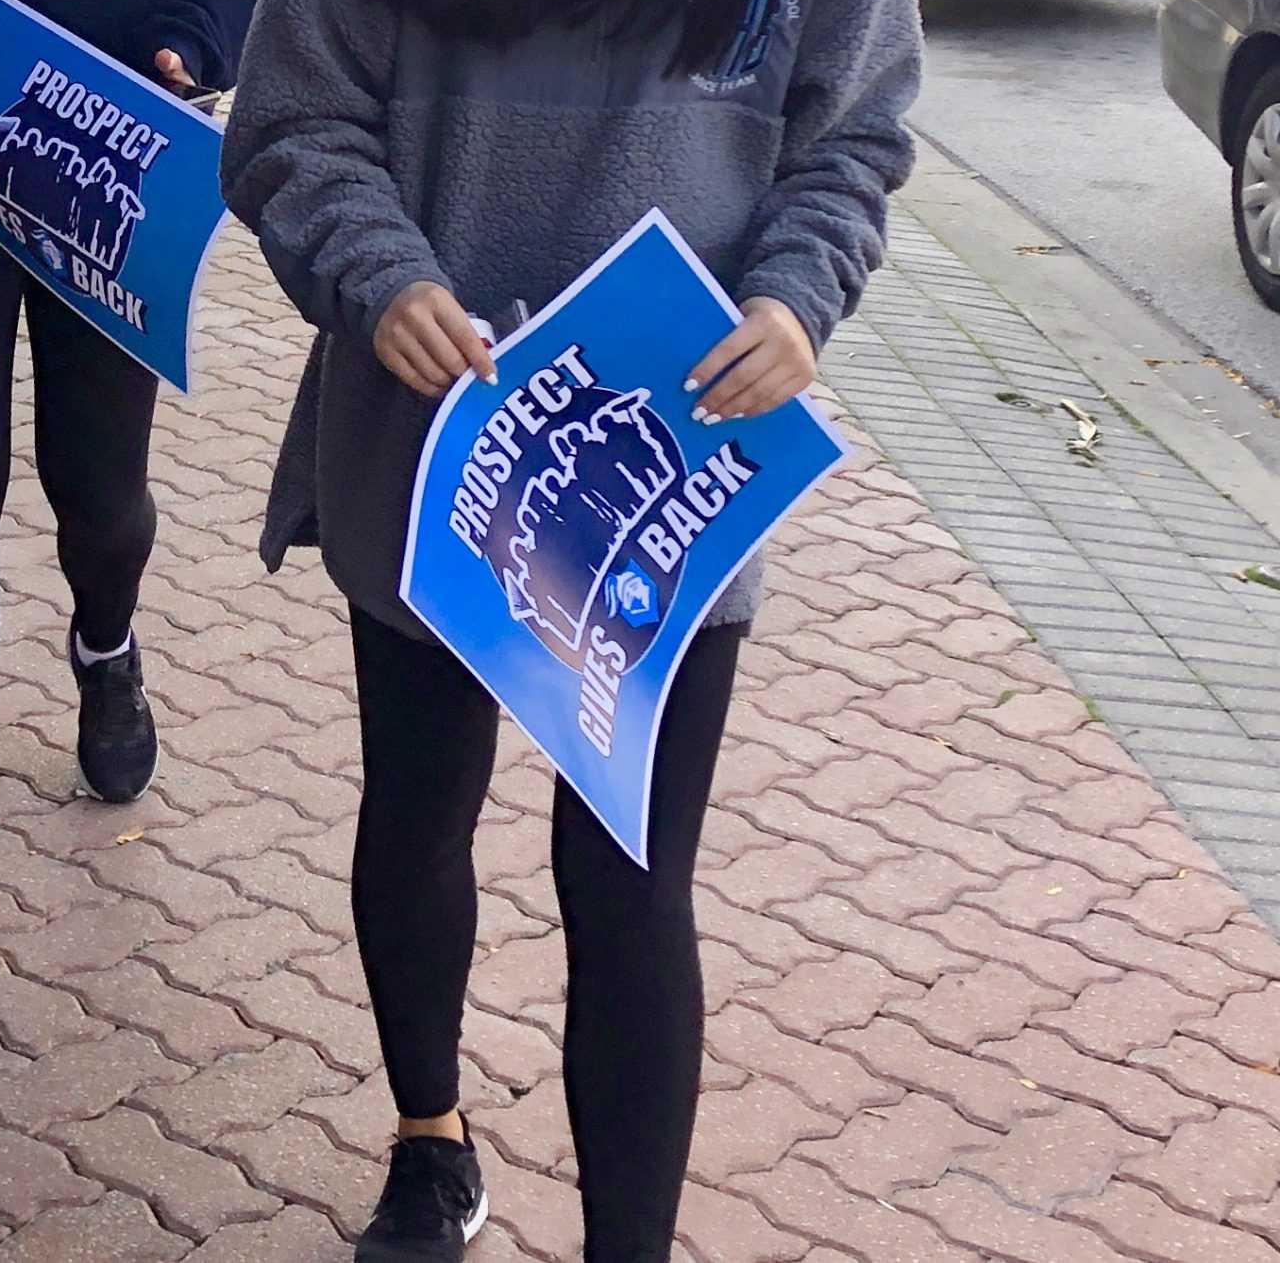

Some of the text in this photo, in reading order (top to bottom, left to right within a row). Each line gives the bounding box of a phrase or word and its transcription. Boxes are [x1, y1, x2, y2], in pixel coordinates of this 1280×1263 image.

[21, 60, 170, 170] PROSPECT
[72, 255, 146, 332] BACK
[448, 344, 599, 559] PROSPECT
[577, 446, 754, 758] GIVES BACK
